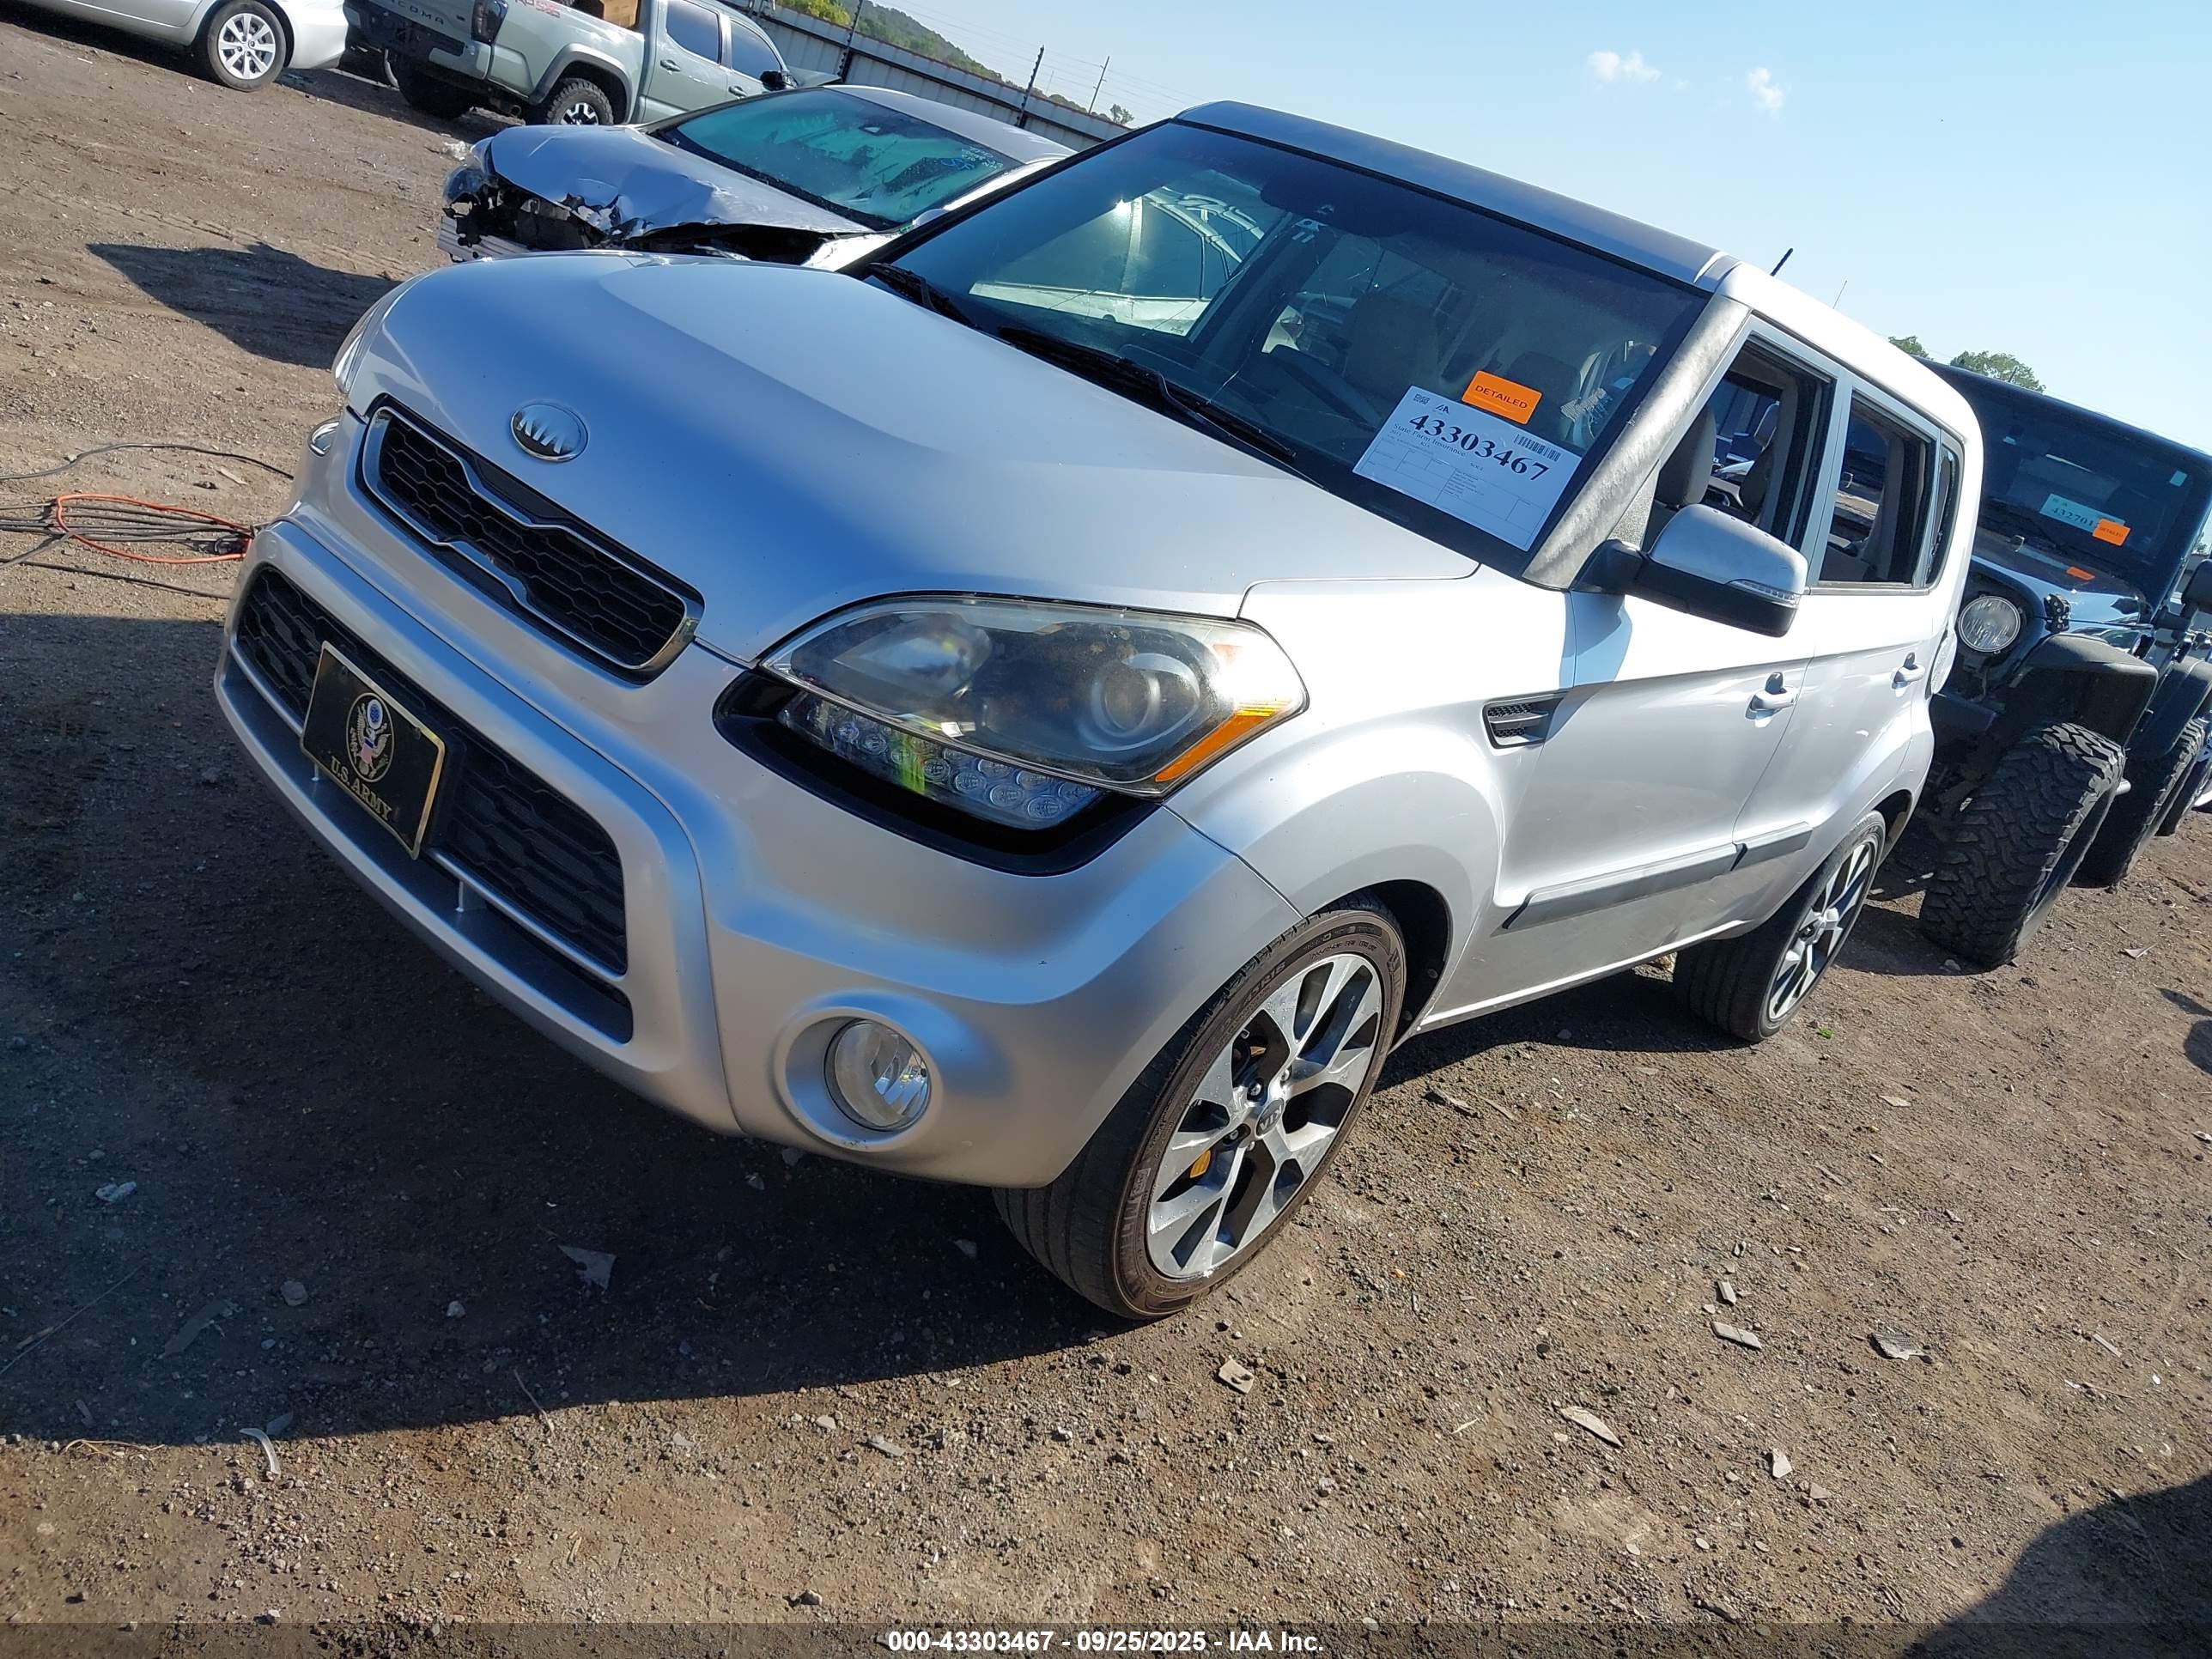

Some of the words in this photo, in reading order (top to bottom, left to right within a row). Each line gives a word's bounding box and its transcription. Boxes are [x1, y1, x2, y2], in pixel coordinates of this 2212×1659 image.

[391, 0, 444, 25] COMA
[1474, 385, 1528, 409] DETAILED
[515, 412, 568, 454] KIA
[1393, 422, 1410, 434] State
[1413, 431, 1431, 441] Farm
[1432, 438, 1466, 457] Insurance
[1409, 415, 1550, 481] 43303467
[2052, 507, 2097, 527] 432701
[331, 756, 350, 786] U.S.
[350, 778, 392, 821] ARMY
